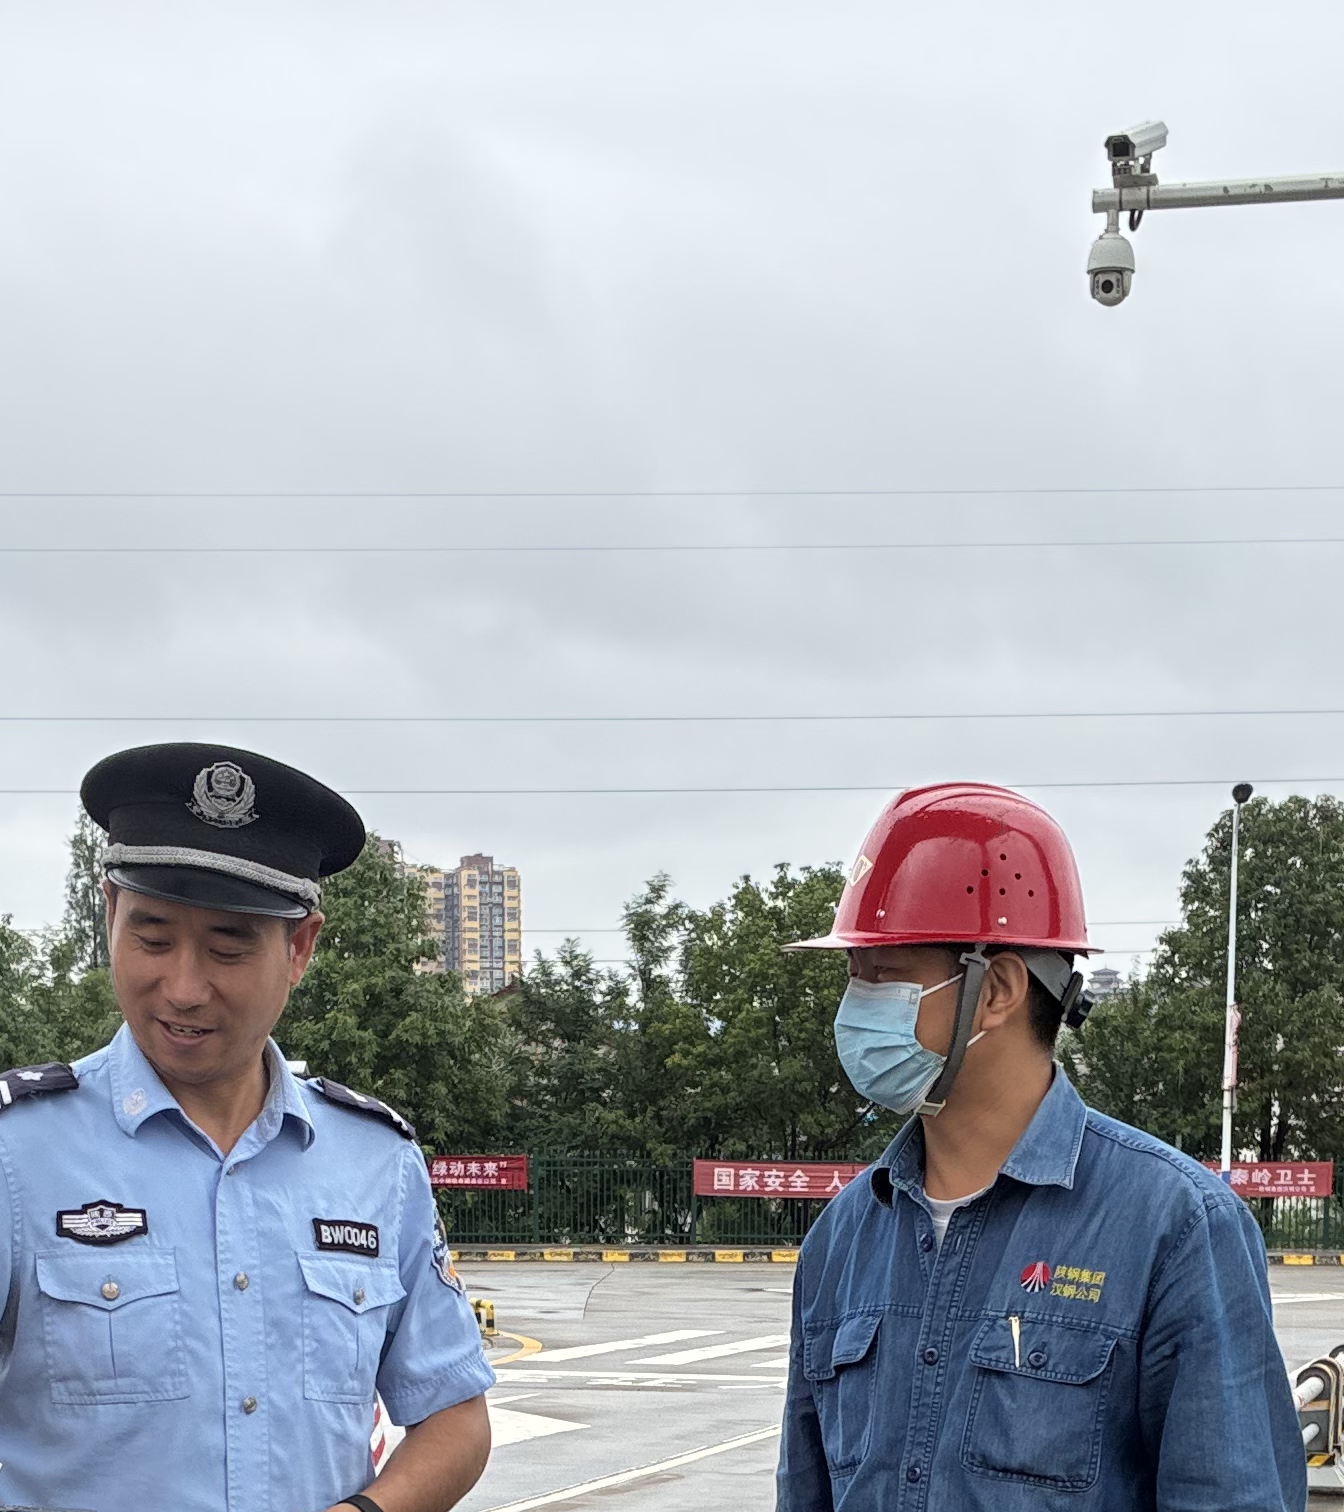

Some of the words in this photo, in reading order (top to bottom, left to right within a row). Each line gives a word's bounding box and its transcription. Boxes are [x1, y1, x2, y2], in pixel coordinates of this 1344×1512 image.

[713, 1167, 810, 1192] 国家安全
[1214, 1168, 1317, 1186] 秦岭卫士
[320, 1224, 377, 1249] BW0046
